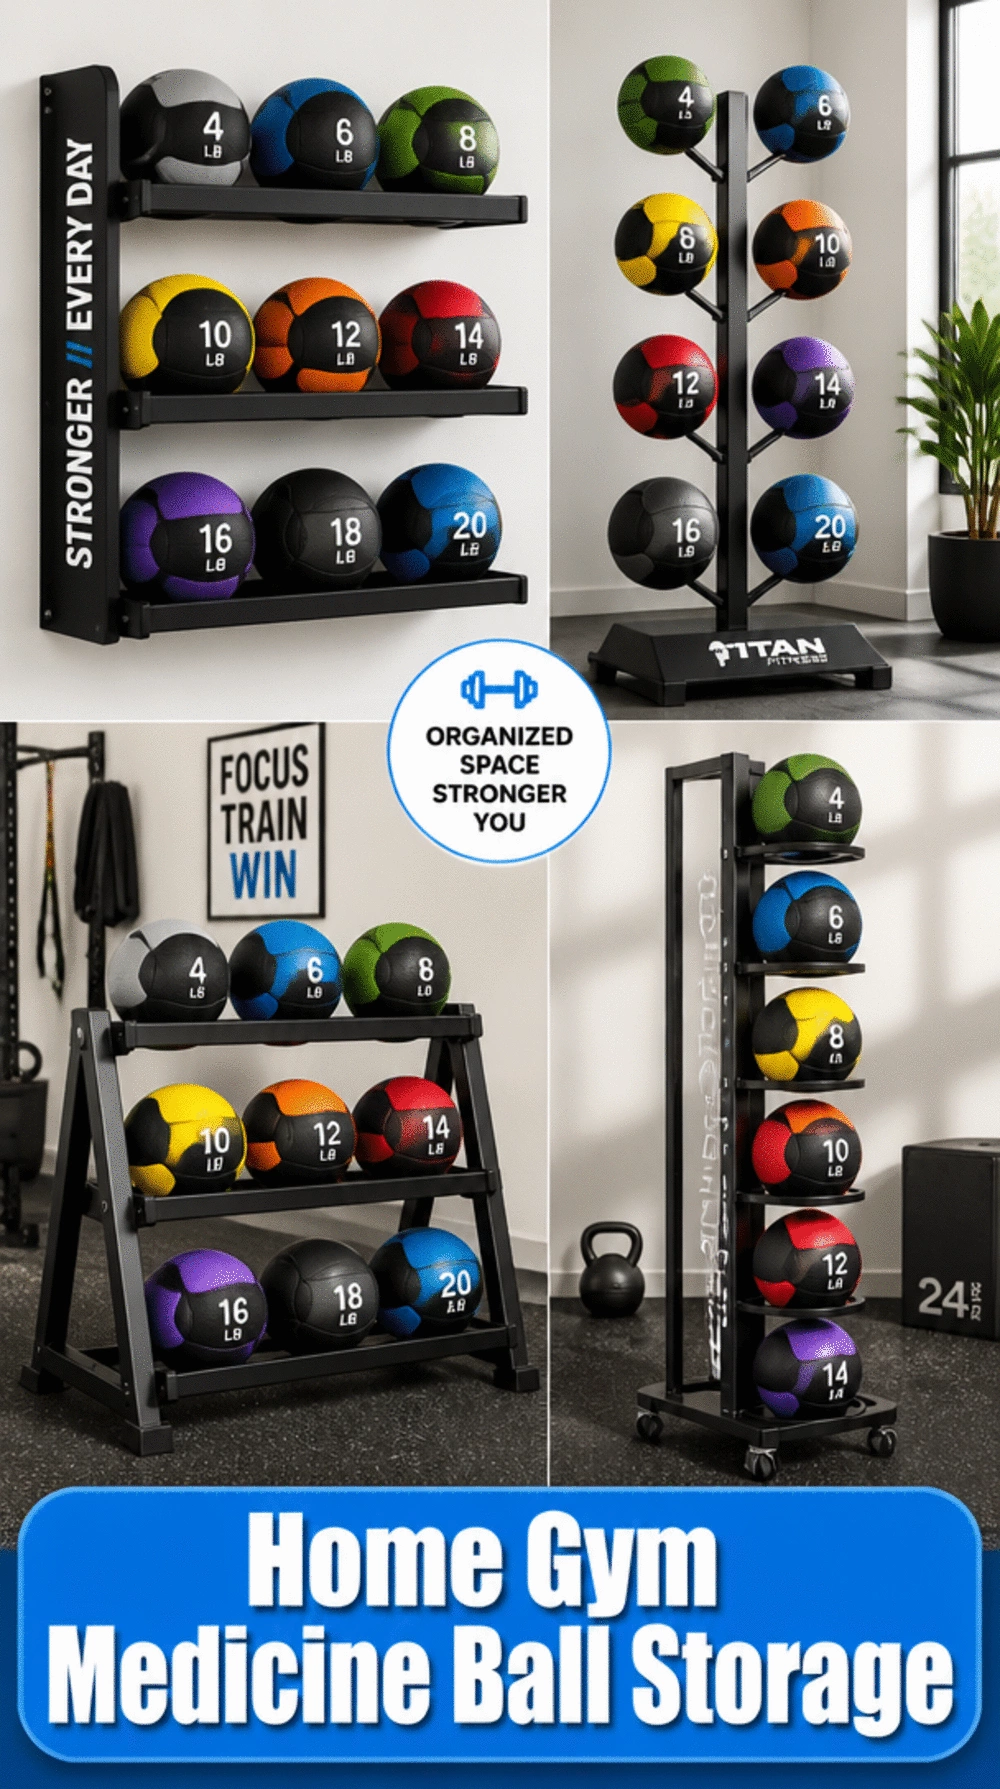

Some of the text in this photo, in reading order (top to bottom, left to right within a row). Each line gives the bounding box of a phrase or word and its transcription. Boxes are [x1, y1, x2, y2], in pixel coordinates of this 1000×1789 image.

[677, 85, 695, 108] 4
[818, 91, 835, 117] 6
[203, 111, 225, 142] 4
[336, 117, 354, 146] 6
[459, 125, 478, 152] 8
[66, 138, 93, 207] DAY
[815, 230, 844, 255] 10
[66, 216, 93, 331] EVERY
[198, 320, 233, 349] 10
[331, 320, 361, 348] 12
[454, 319, 487, 350] 14
[672, 368, 703, 395] 12
[814, 370, 844, 396] 14
[66, 377, 93, 570] STRONGER
[199, 522, 233, 554] 16
[330, 516, 362, 547] 18
[453, 508, 487, 540] 20
[672, 515, 704, 543] 16
[814, 512, 849, 540] 20
[220, 743, 309, 795] FOCUS
[828, 786, 845, 810] 4
[220, 796, 308, 845] TRAIN
[230, 849, 297, 900] WIN
[828, 904, 844, 930] 6
[188, 956, 207, 984] 4
[303, 955, 324, 984] 6
[418, 956, 434, 982] 8
[828, 1023, 845, 1050] 8
[199, 1126, 230, 1155] 10
[313, 1120, 342, 1147] 12
[422, 1114, 451, 1140] 14
[822, 1137, 849, 1163] 10
[822, 1251, 848, 1276] 12
[333, 1281, 363, 1311] 18
[438, 1268, 472, 1298] 20
[218, 1296, 249, 1326] 16
[918, 1276, 970, 1319] 24
[822, 1360, 848, 1387] 14
